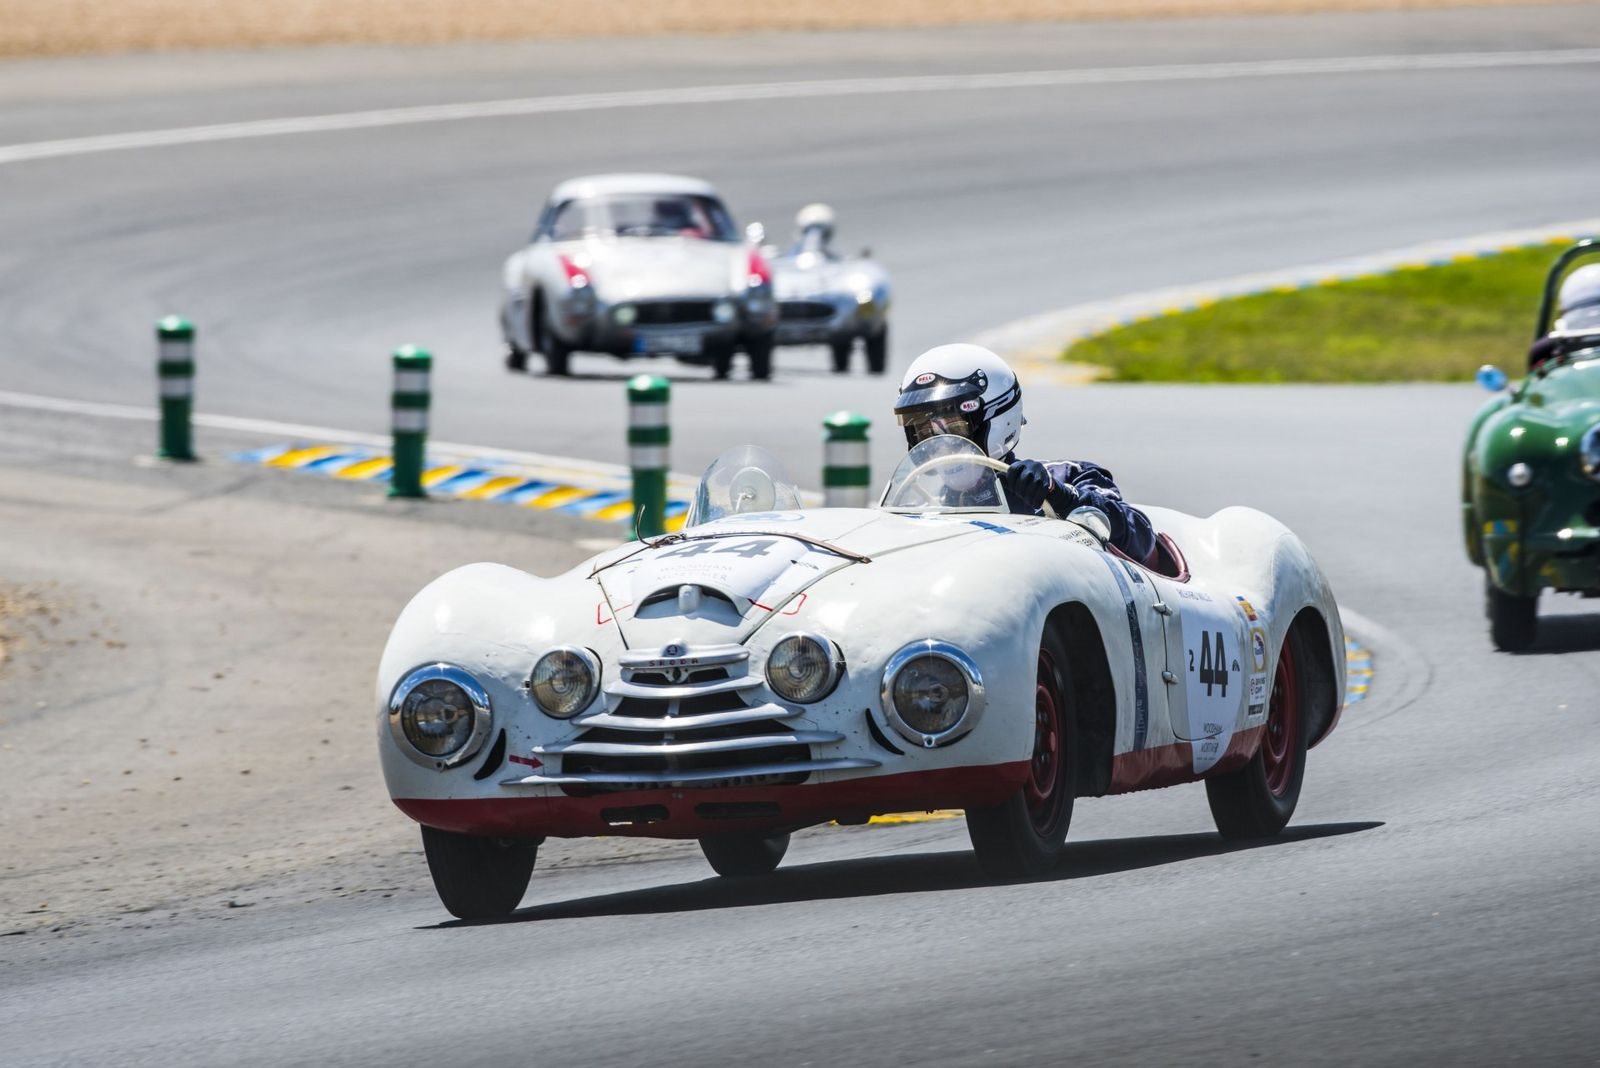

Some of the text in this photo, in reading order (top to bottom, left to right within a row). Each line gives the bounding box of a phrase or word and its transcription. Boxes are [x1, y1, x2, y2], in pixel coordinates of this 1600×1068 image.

[918, 375, 932, 383] BELL
[962, 401, 977, 410] BELL
[655, 539, 779, 560] 44
[1188, 630, 1229, 698] 2 44
